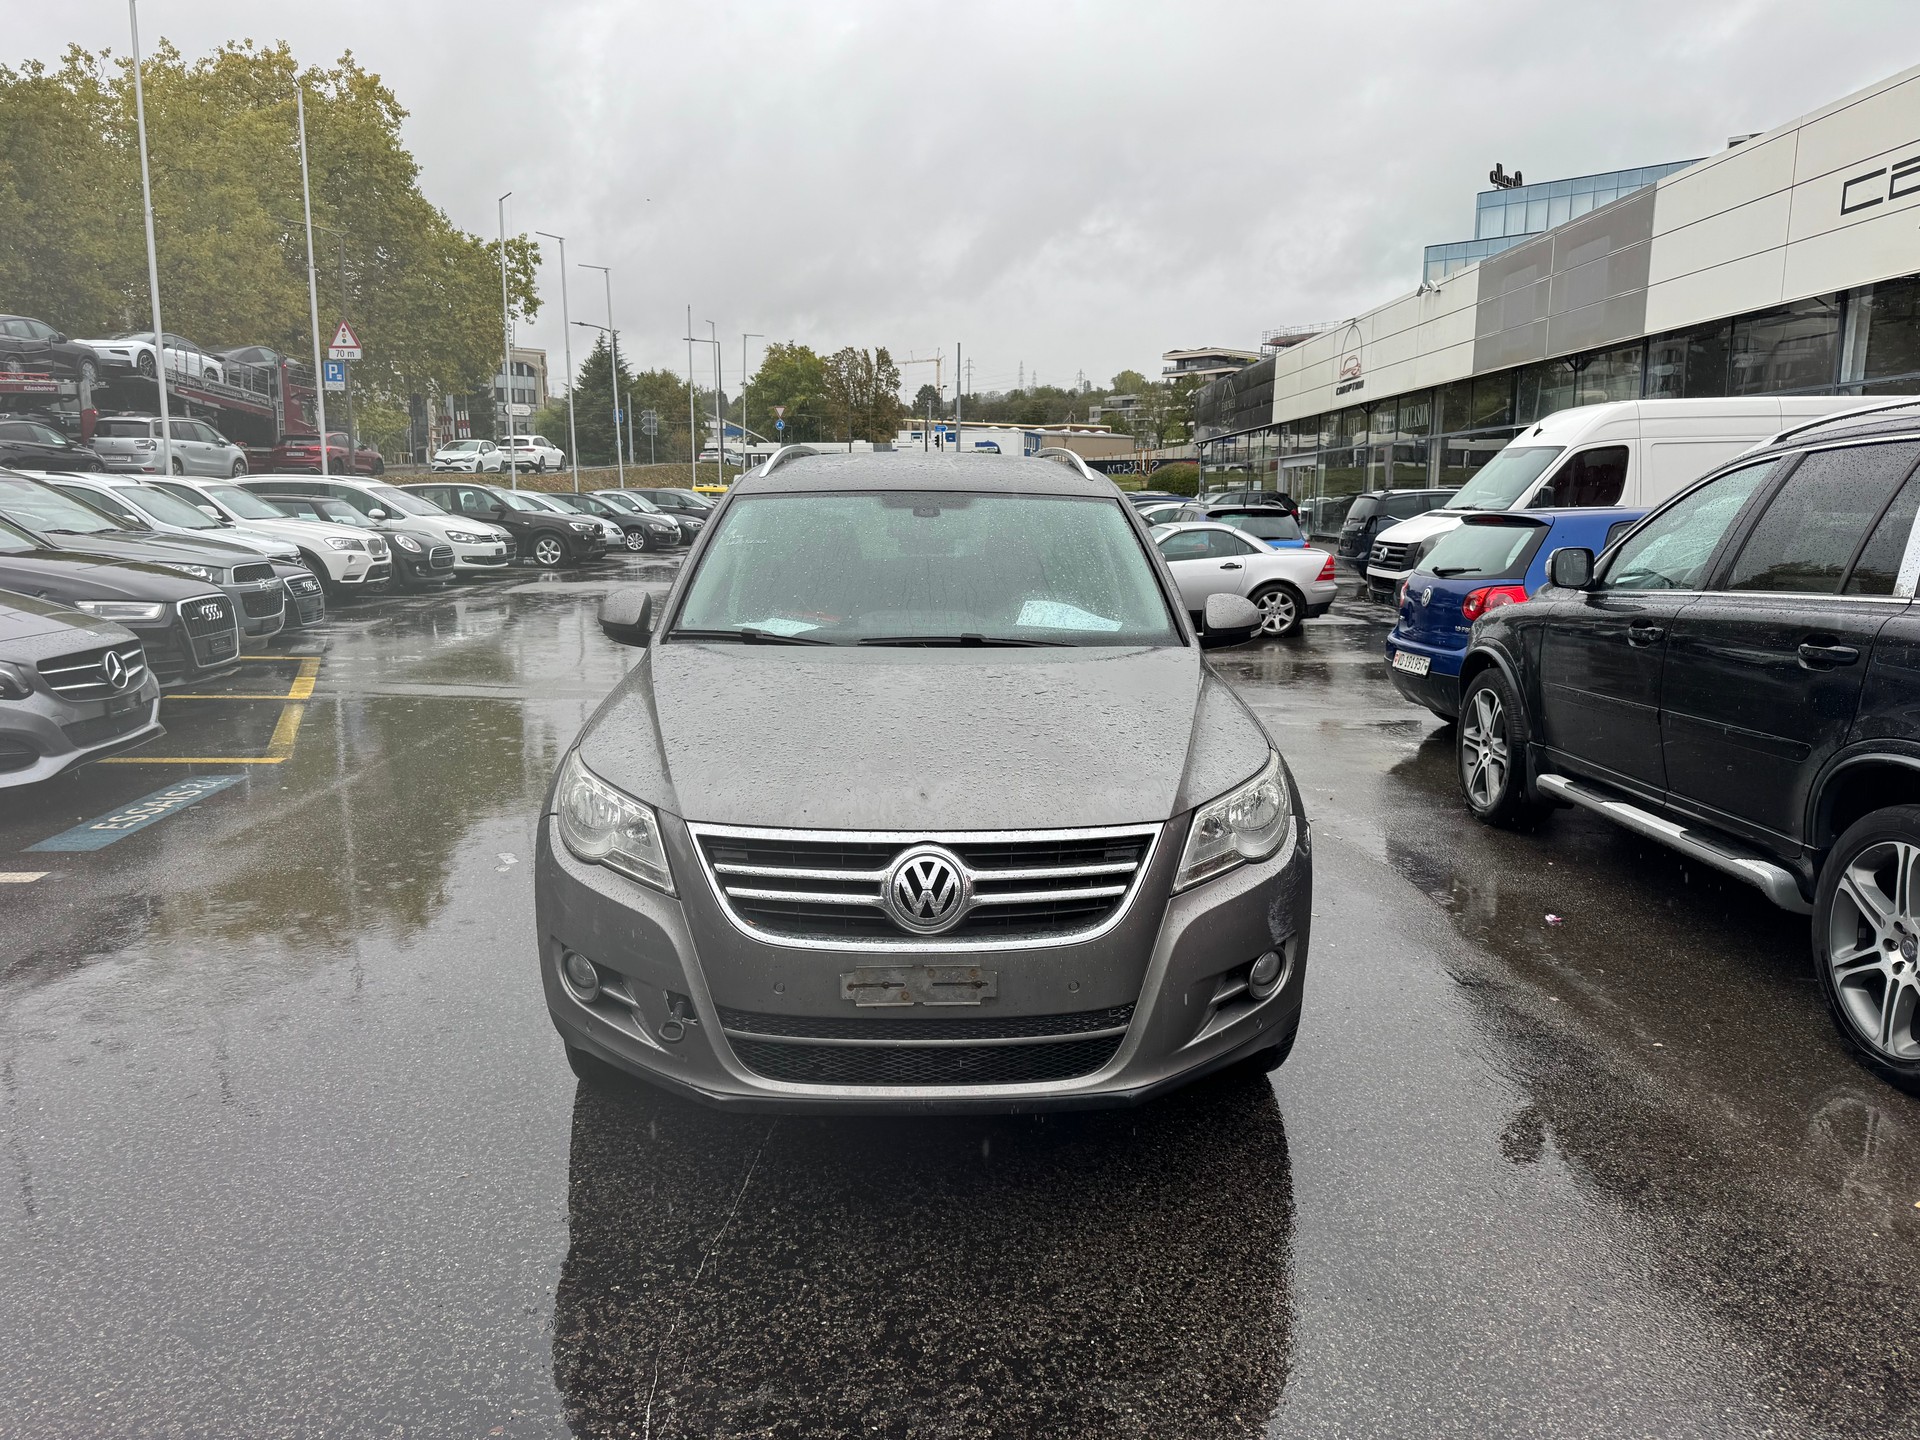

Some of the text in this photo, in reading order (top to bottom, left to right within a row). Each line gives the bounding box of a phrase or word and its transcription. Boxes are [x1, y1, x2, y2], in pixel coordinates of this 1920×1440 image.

[336, 349, 345, 358] 70
[328, 364, 338, 379] P
[89, 790, 203, 830] ESSAIS
